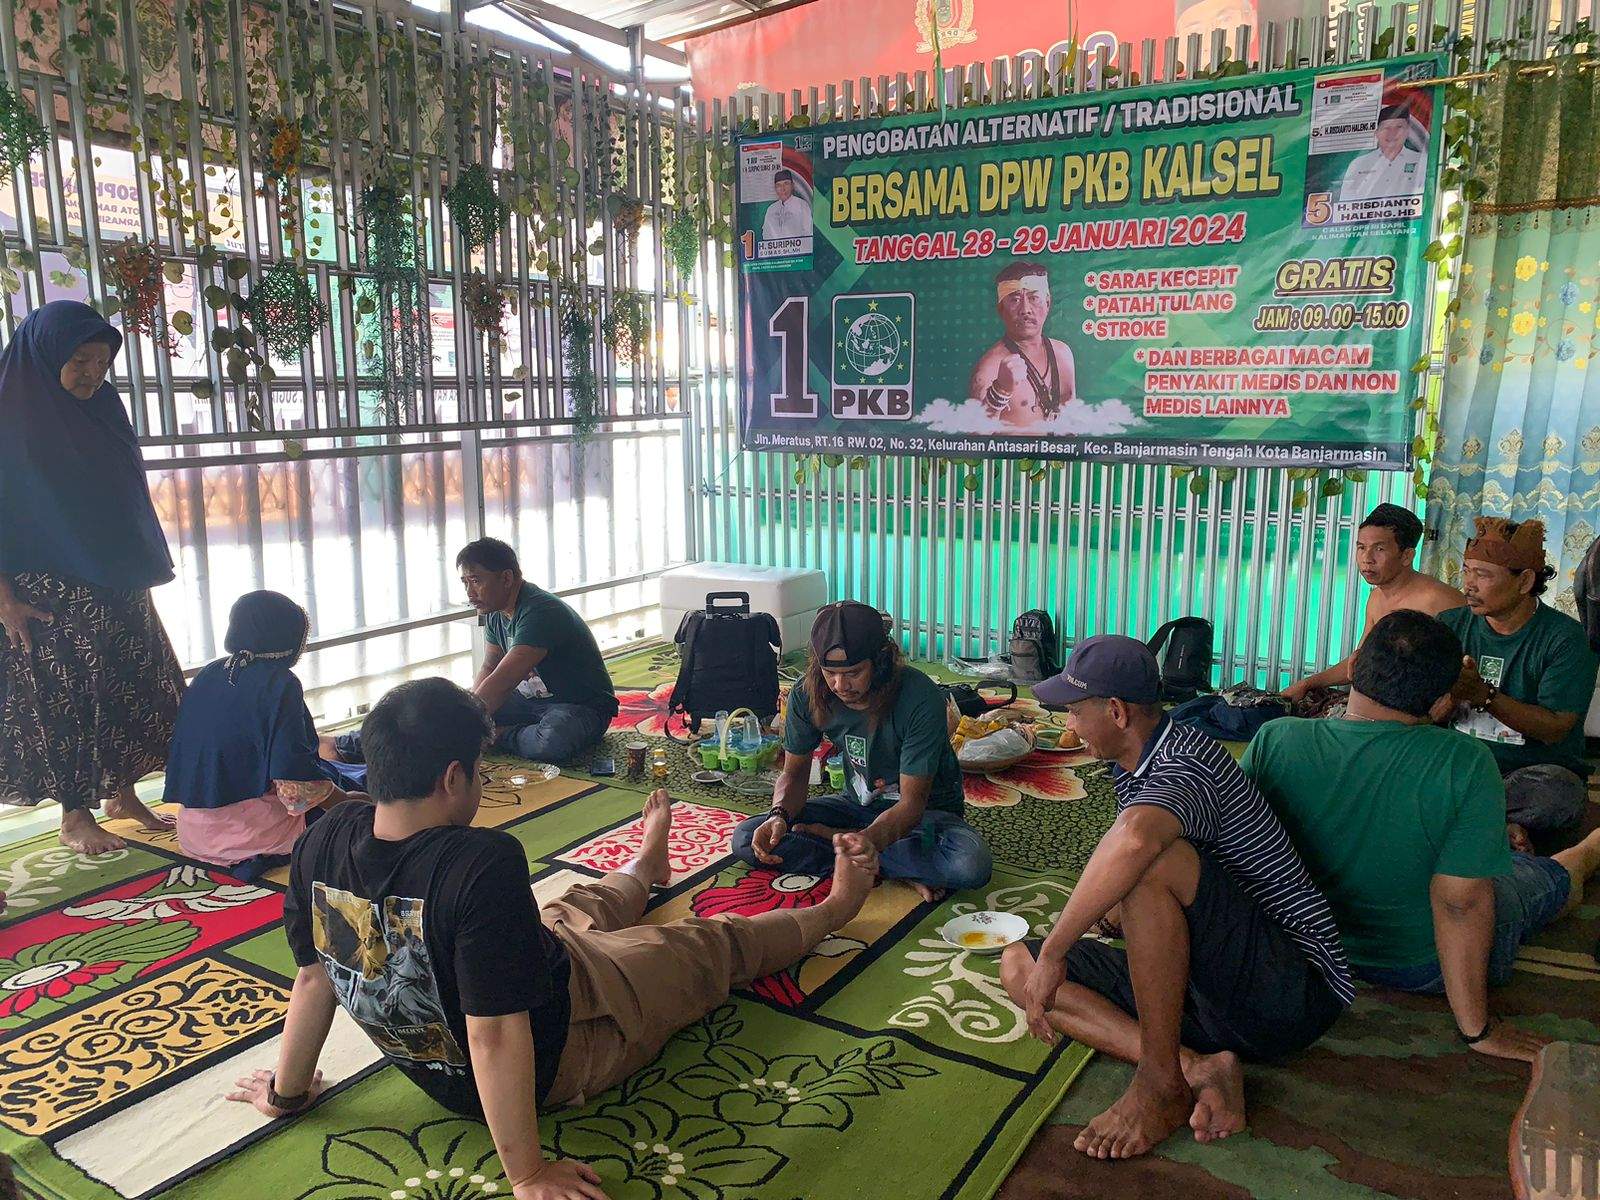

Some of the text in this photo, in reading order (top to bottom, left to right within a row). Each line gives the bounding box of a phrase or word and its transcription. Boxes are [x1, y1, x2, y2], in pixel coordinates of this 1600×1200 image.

[823, 122, 959, 160] PENGOBATAN
[962, 107, 1100, 145] ALTERNATIF
[1121, 85, 1300, 128] TRADISIONAL
[832, 138, 1280, 223] BERSAMA DPW PKB KALSEL
[1306, 192, 1333, 225] 5
[741, 230, 755, 260] 1
[854, 232, 959, 263] TANGGAL
[963, 229, 996, 257] 28
[1013, 226, 1048, 254] 29
[1049, 218, 1168, 251] JANUARI
[1170, 212, 1247, 245] 2024
[1099, 268, 1238, 290] SARAF KECEPIT
[1278, 259, 1393, 290] GRATIS
[1098, 293, 1233, 313] PATAH TULANG
[1257, 308, 1289, 328] JAM
[1364, 304, 1408, 326] 15.00
[1097, 320, 1166, 337] STROKE
[769, 296, 818, 418] 1
[1149, 347, 1370, 366] DAN BERBAGAI MACAM
[1147, 373, 1396, 390] PENYAKIT MEDIS DAN NON
[833, 388, 910, 416] PKB
[1146, 398, 1288, 415] MEDIS LAINNYA
[754, 434, 770, 445] Jln.
[928, 439, 985, 451] Kelurahan
[987, 440, 1038, 452] Antasari
[1041, 441, 1079, 456] Besar,
[1084, 442, 1111, 454] Kec.
[1114, 442, 1197, 458] Banjarmasin
[1201, 444, 1252, 459] Tengah
[1256, 445, 1289, 460] Kota
[1292, 446, 1387, 462] Banjarmasin
